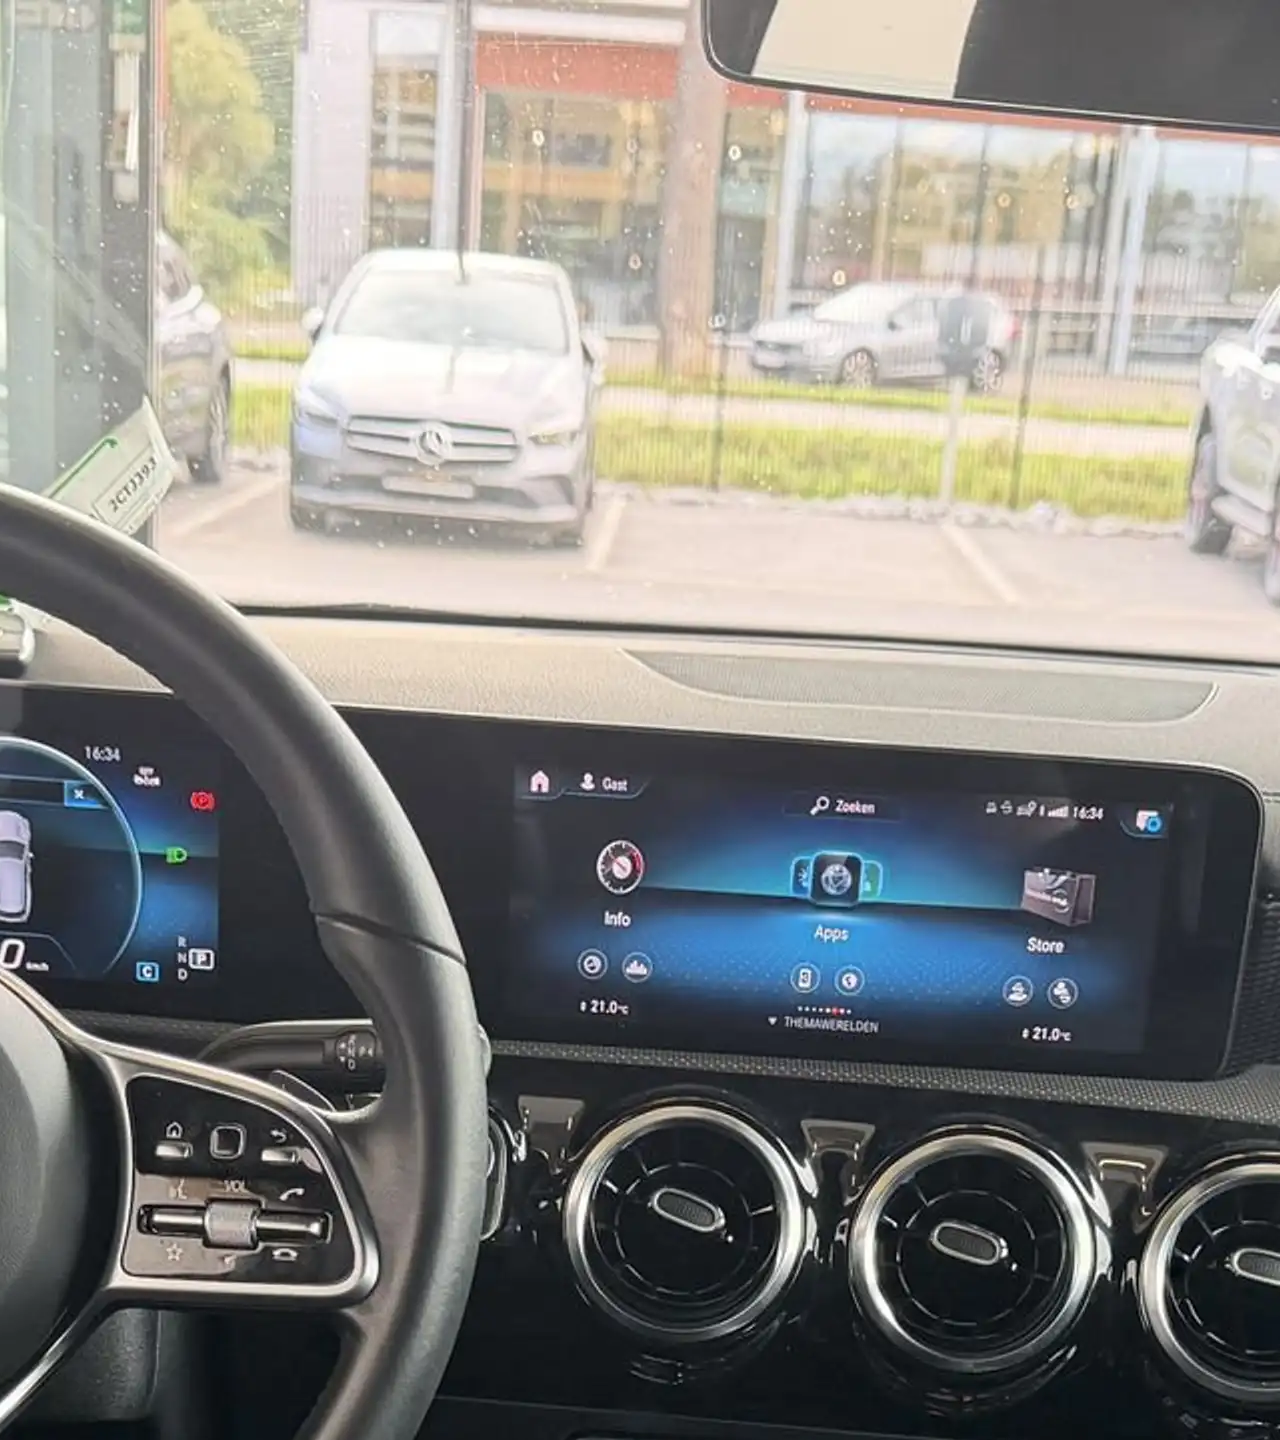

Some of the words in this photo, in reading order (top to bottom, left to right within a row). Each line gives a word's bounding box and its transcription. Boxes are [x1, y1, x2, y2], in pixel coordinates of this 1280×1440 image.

[84, 745, 121, 761] 16:34
[602, 777, 628, 792] Gast
[835, 800, 876, 815] Zoeken
[1073, 805, 1104, 820] 16:34
[604, 910, 632, 928] Info
[813, 925, 849, 943] Apps
[1026, 936, 1065, 953] Store
[783, 1015, 879, 1034] THEMAWERELDEN
